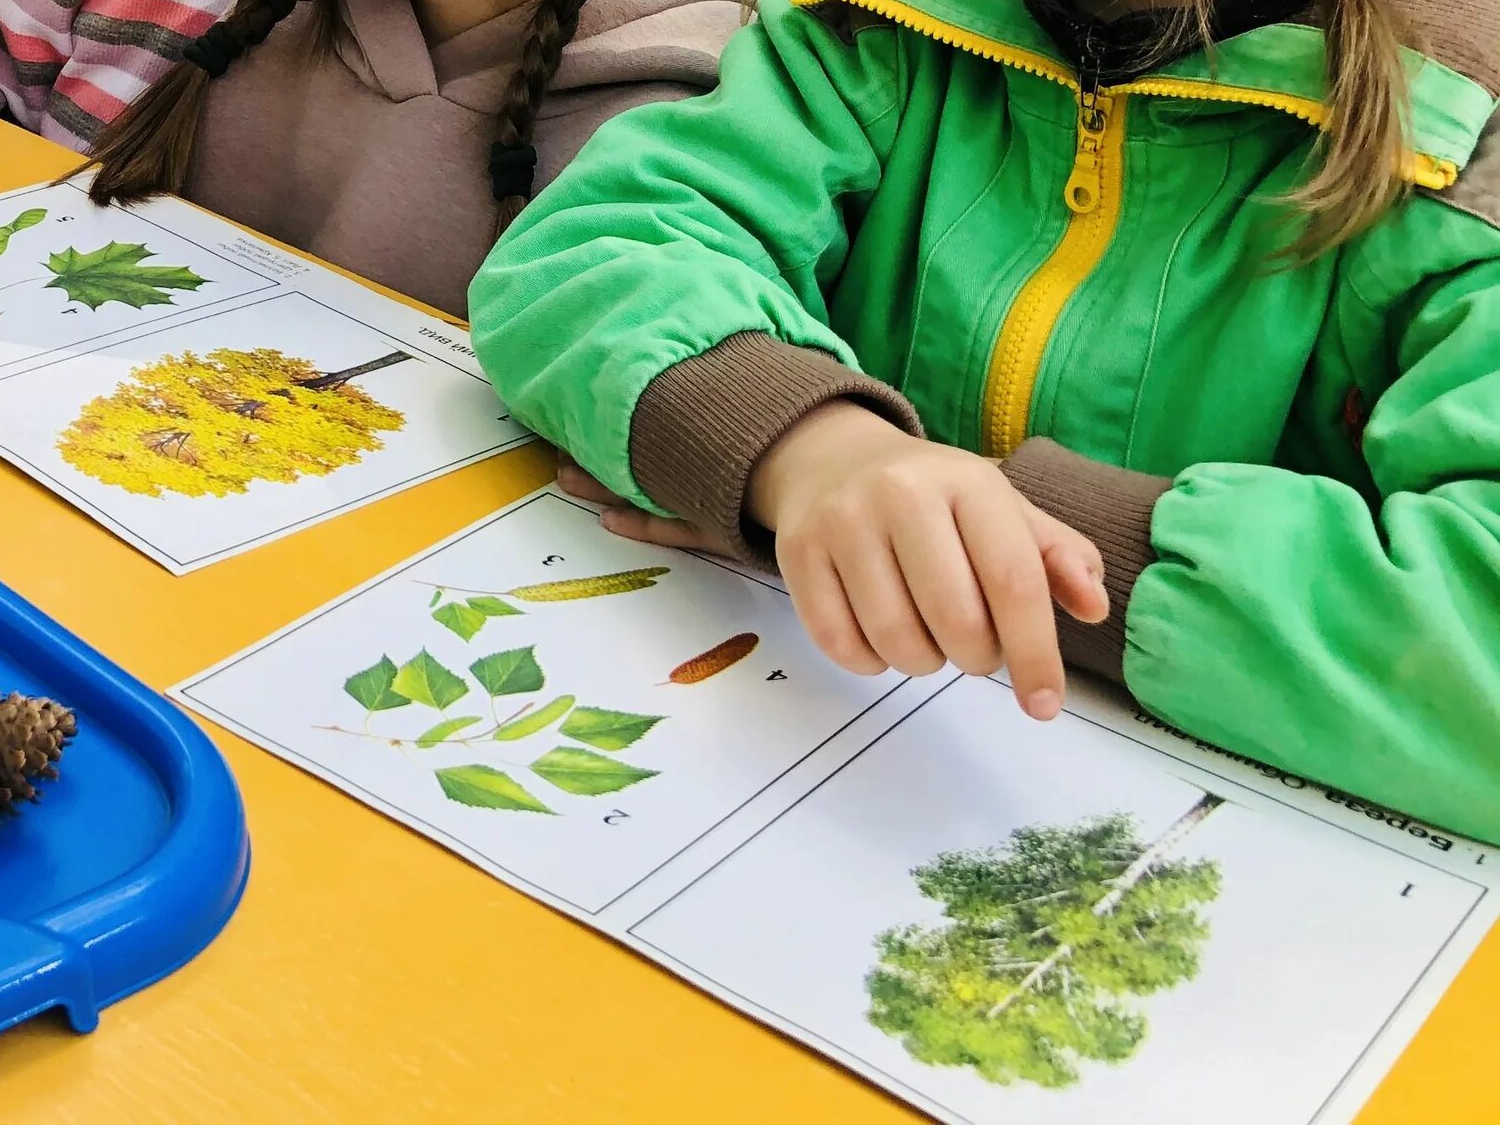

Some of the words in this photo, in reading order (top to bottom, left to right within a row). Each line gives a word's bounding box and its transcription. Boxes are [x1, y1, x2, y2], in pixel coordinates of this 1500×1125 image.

[56, 215, 75, 223] 5
[61, 307, 78, 315] 4
[542, 554, 565, 566] 3
[765, 669, 788, 681] 4
[603, 809, 631, 826] 2
[1400, 882, 1415, 897] 1
